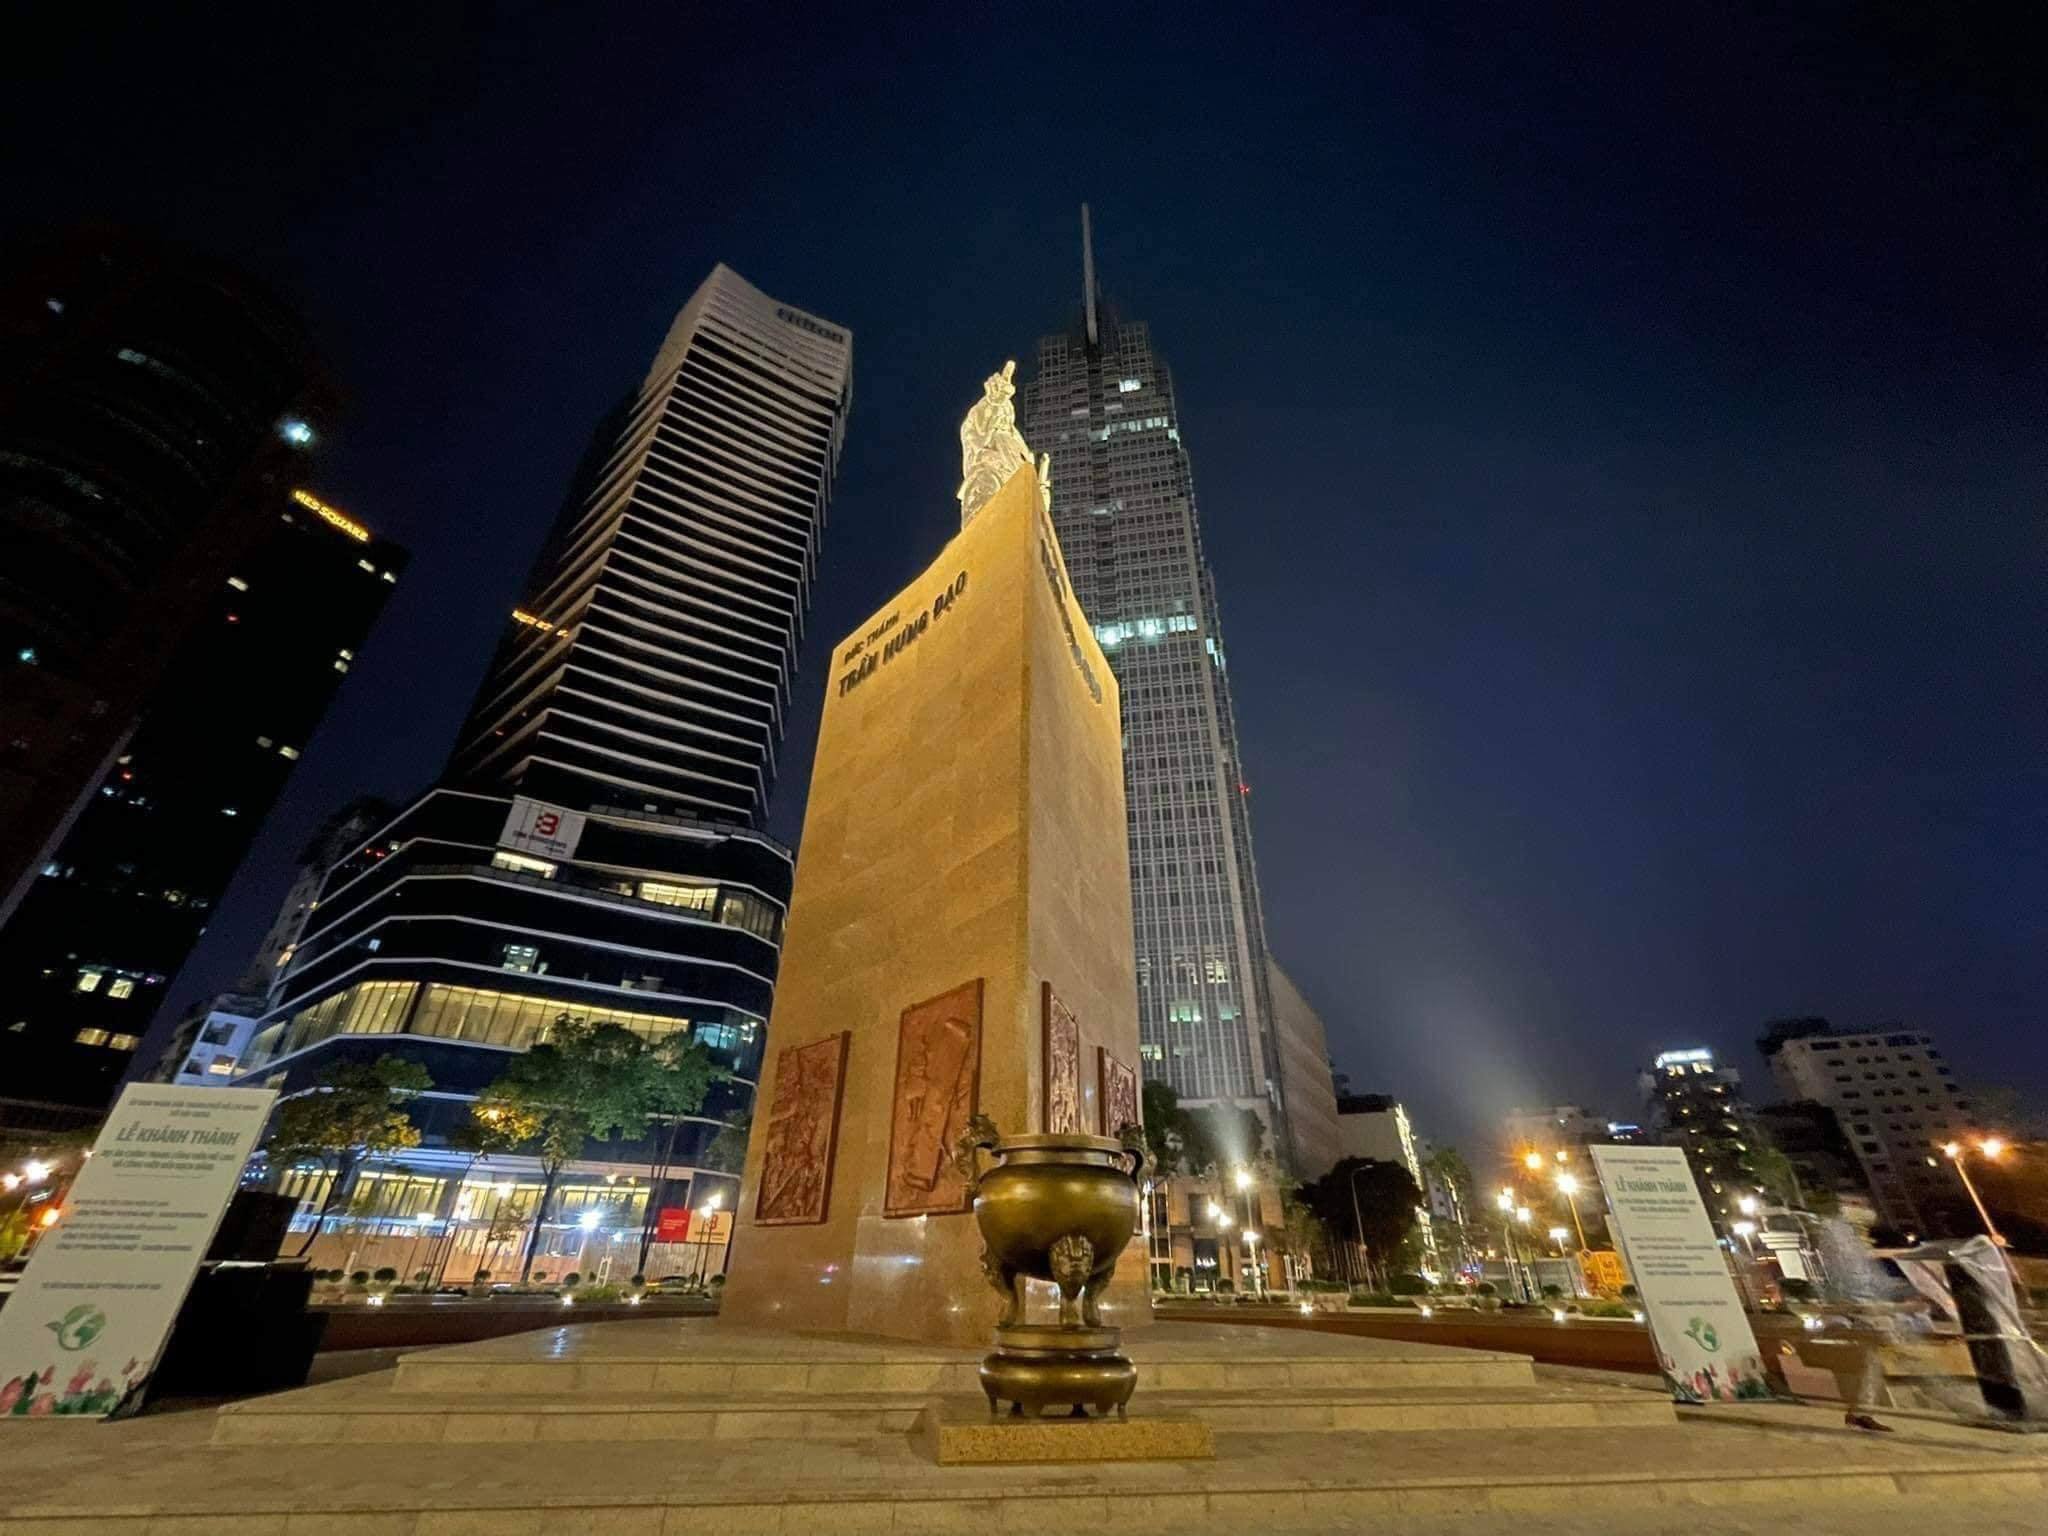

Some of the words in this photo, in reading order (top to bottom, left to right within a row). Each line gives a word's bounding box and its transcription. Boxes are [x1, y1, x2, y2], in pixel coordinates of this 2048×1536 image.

[839, 650, 879, 697] TRẦN
[933, 570, 967, 621] ĐẠO
[115, 1120, 140, 1142] LỄ
[135, 1124, 190, 1144] KHÁNH
[189, 1127, 241, 1146] THÀNH
